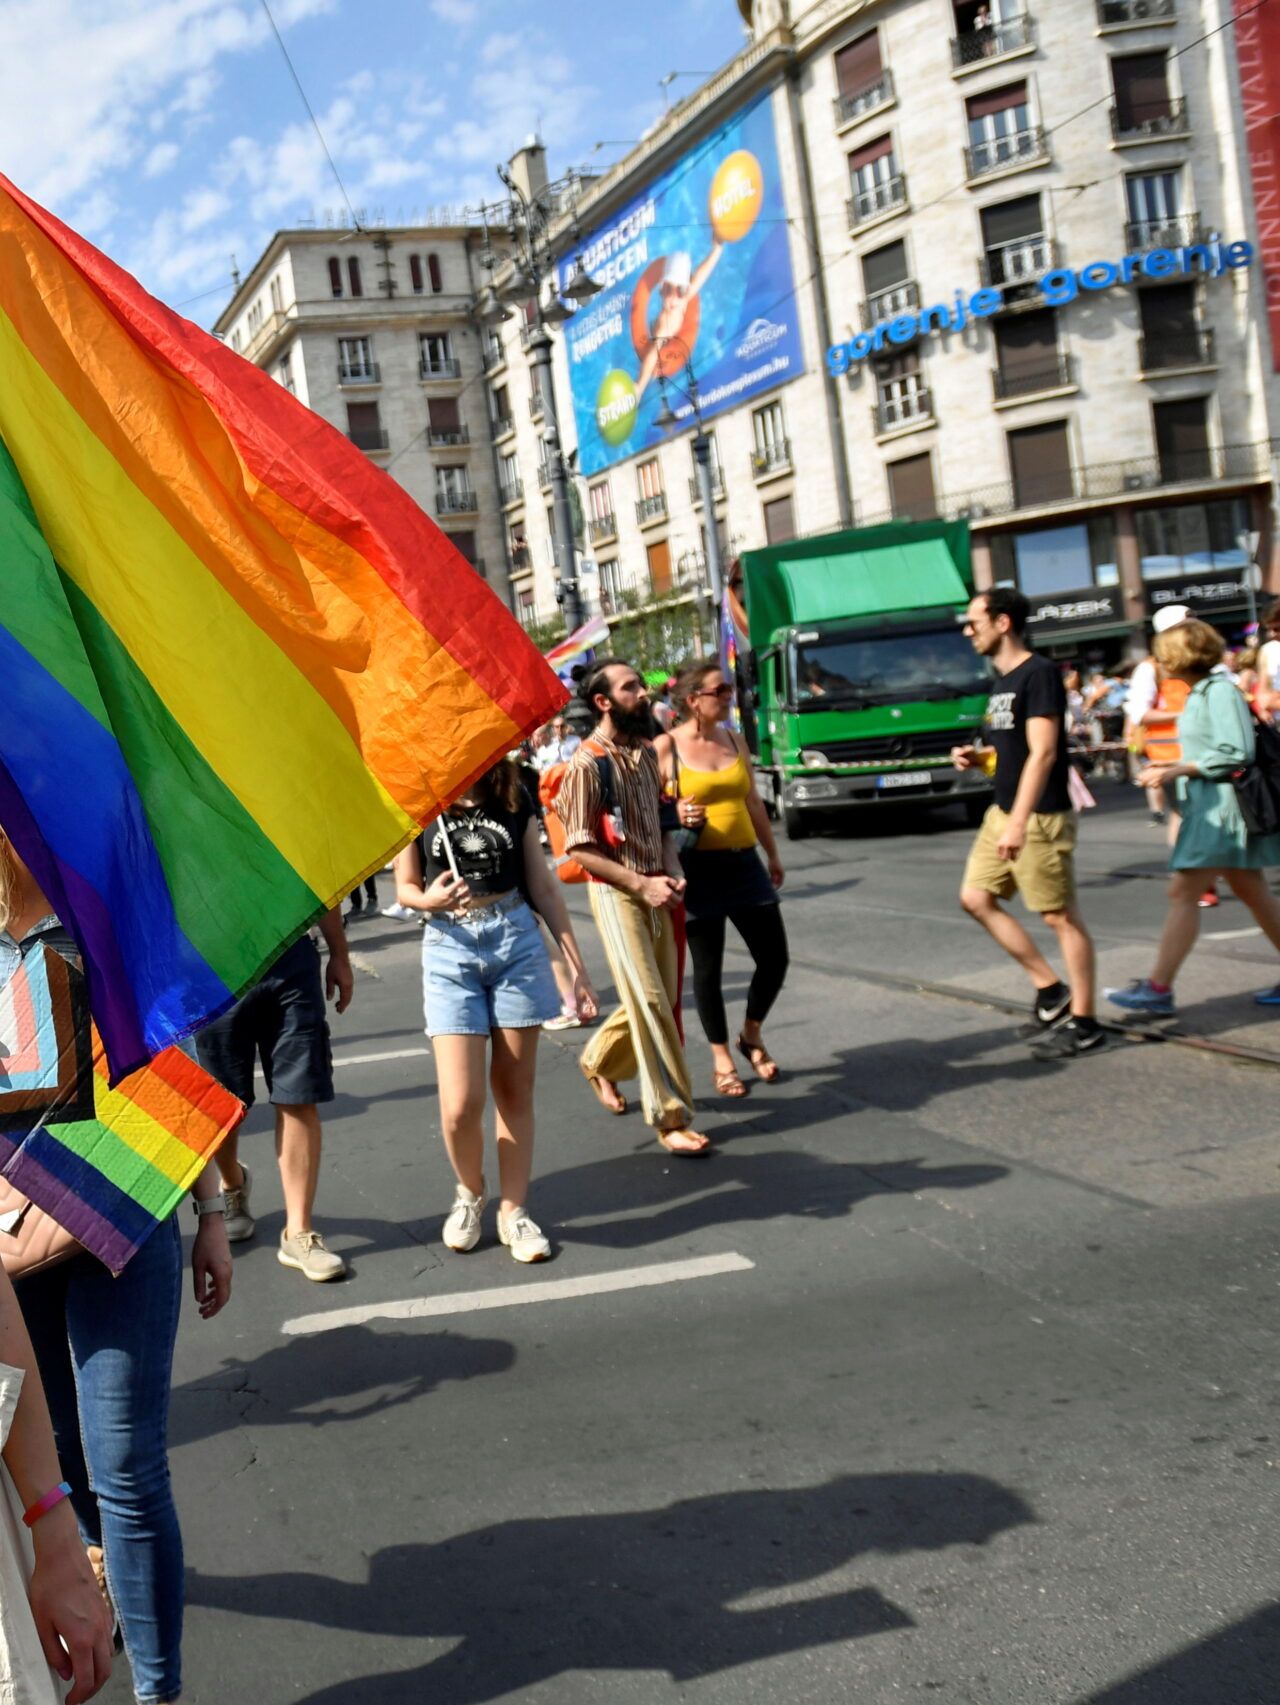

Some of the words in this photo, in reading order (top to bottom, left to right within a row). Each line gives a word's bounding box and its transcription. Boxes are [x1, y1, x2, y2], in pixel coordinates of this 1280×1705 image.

[1232, 0, 1269, 132] WALKE
[713, 177, 755, 218] HOTEL
[563, 199, 655, 291] AUATICUM
[1038, 231, 1253, 306] gorenje
[826, 286, 1003, 377] gorenje
[599, 394, 636, 427] STRAND
[675, 355, 789, 418] wwwfurdokomplexum.hu
